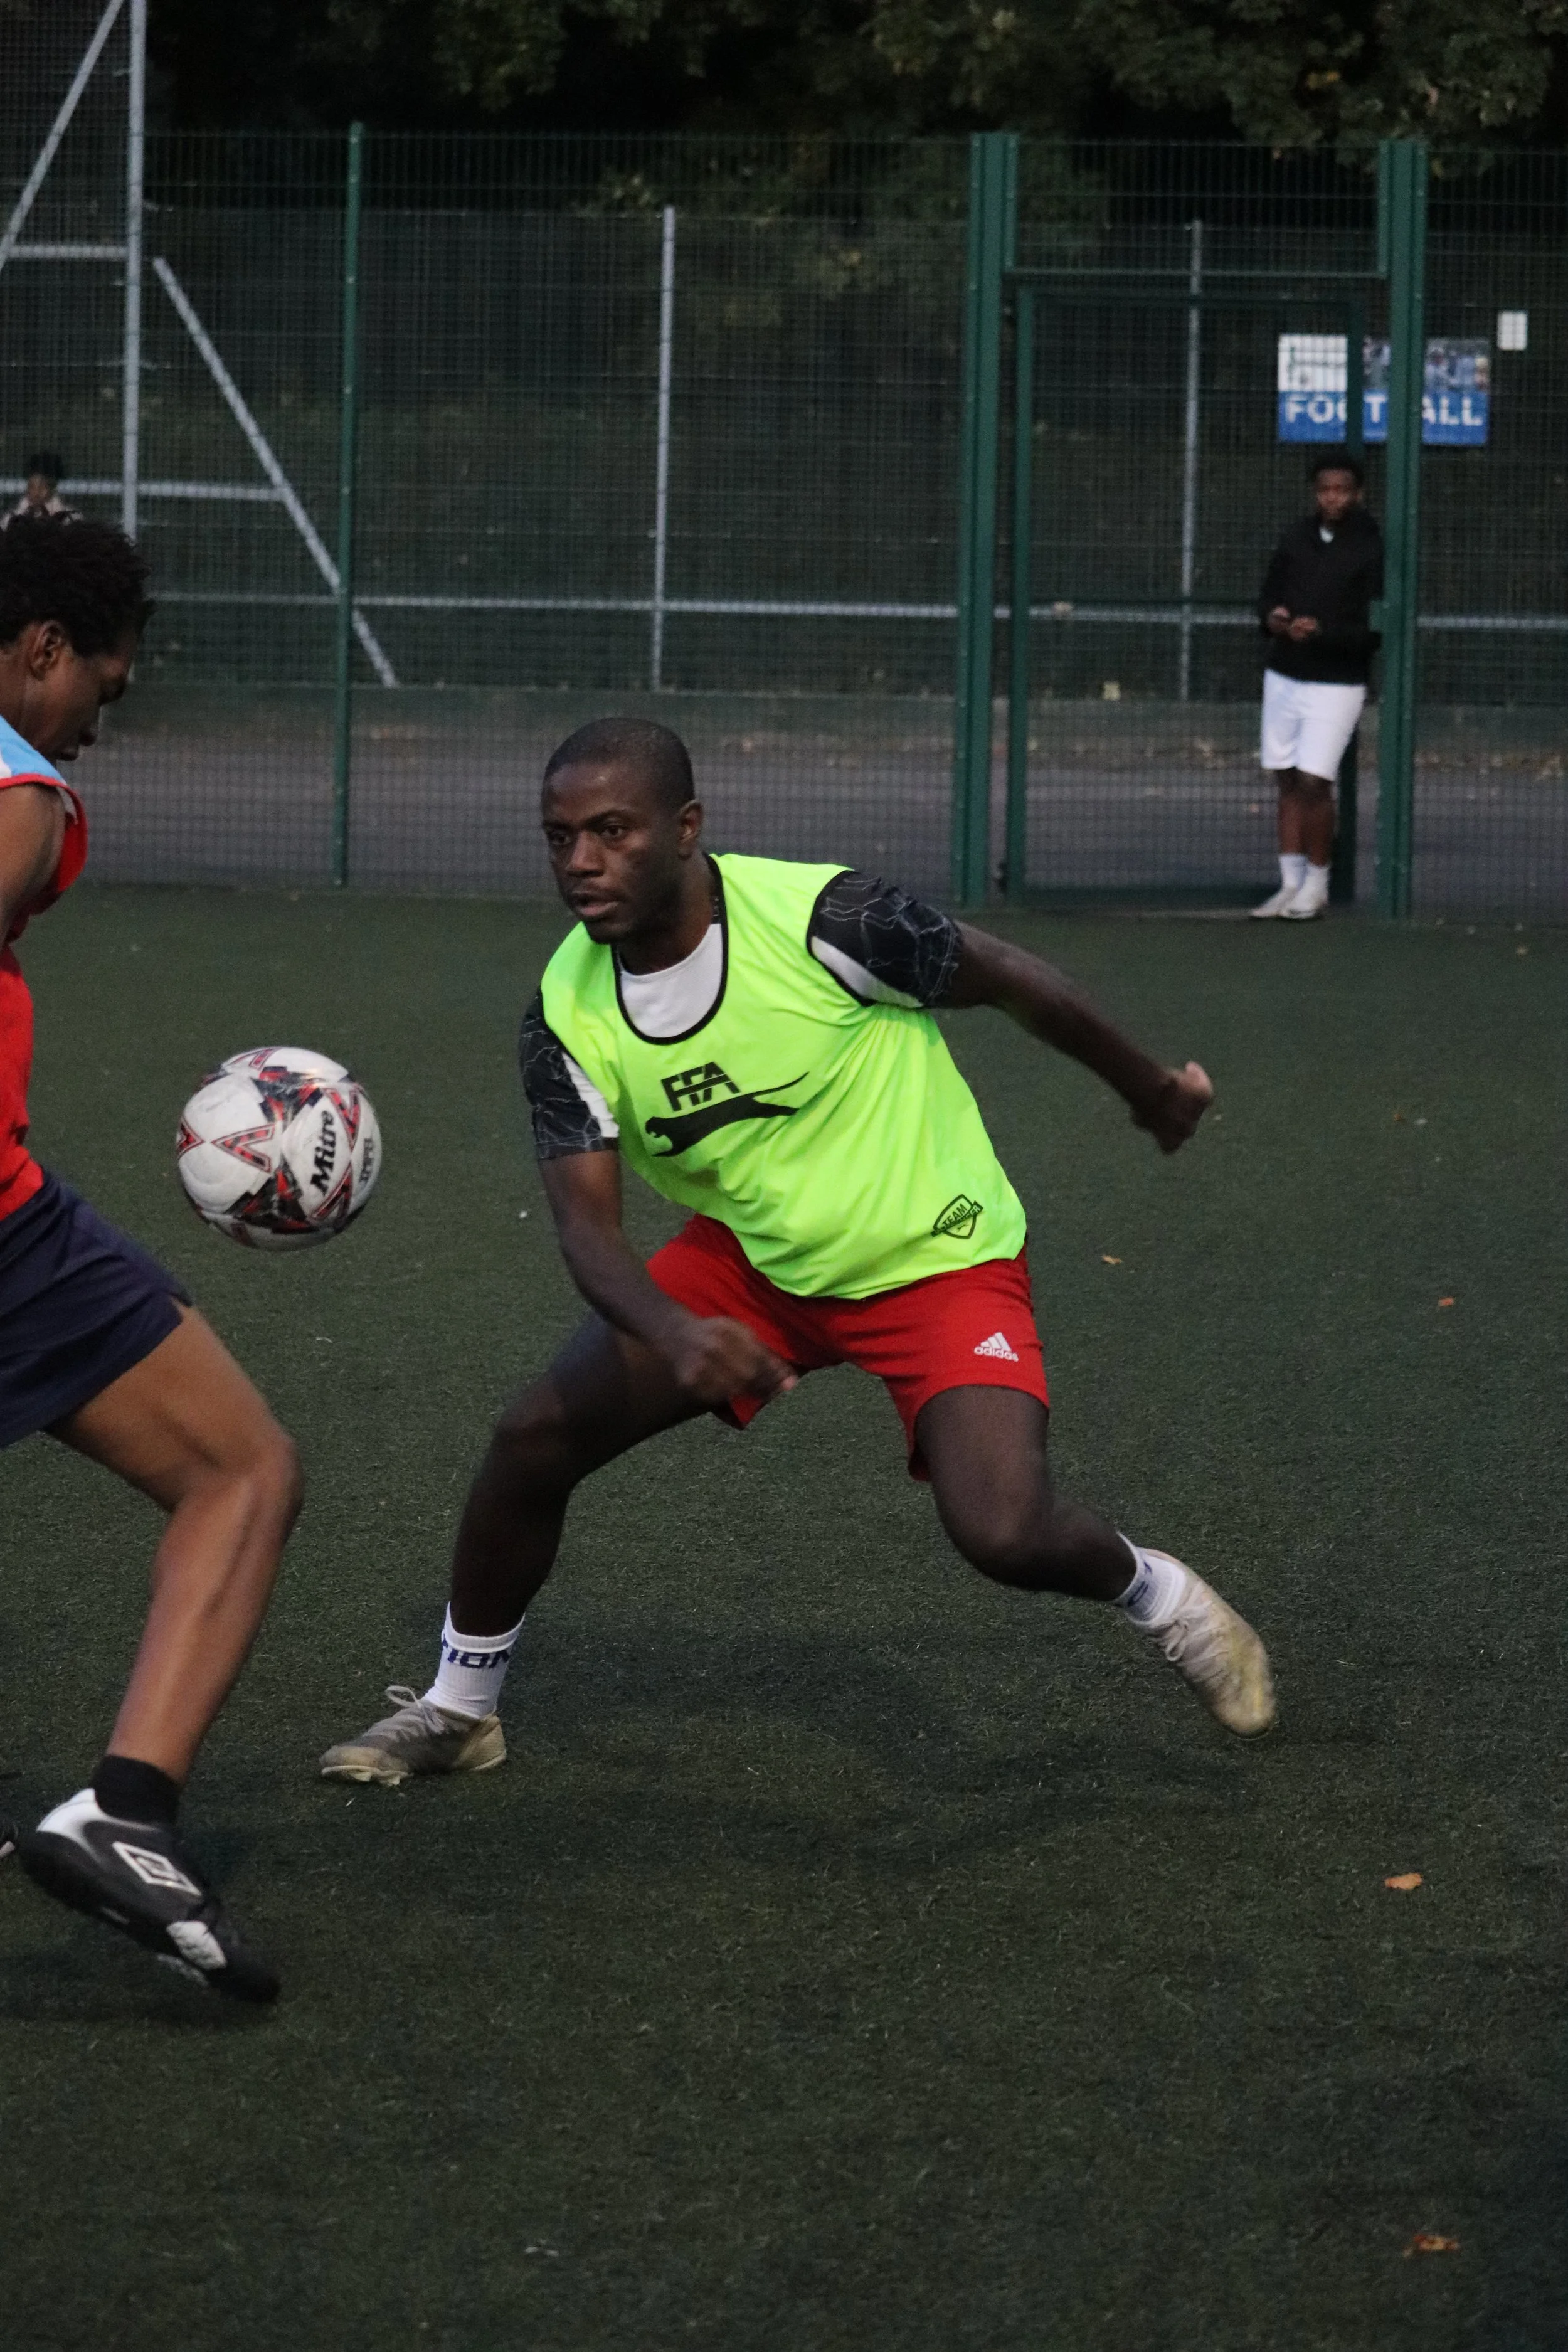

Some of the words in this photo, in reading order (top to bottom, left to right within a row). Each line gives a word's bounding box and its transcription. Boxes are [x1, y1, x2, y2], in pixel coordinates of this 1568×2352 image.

[1286, 395, 1484, 426] FOTALL
[942, 1203, 968, 1226] TEAM
[973, 1346, 1019, 1362] adidas
